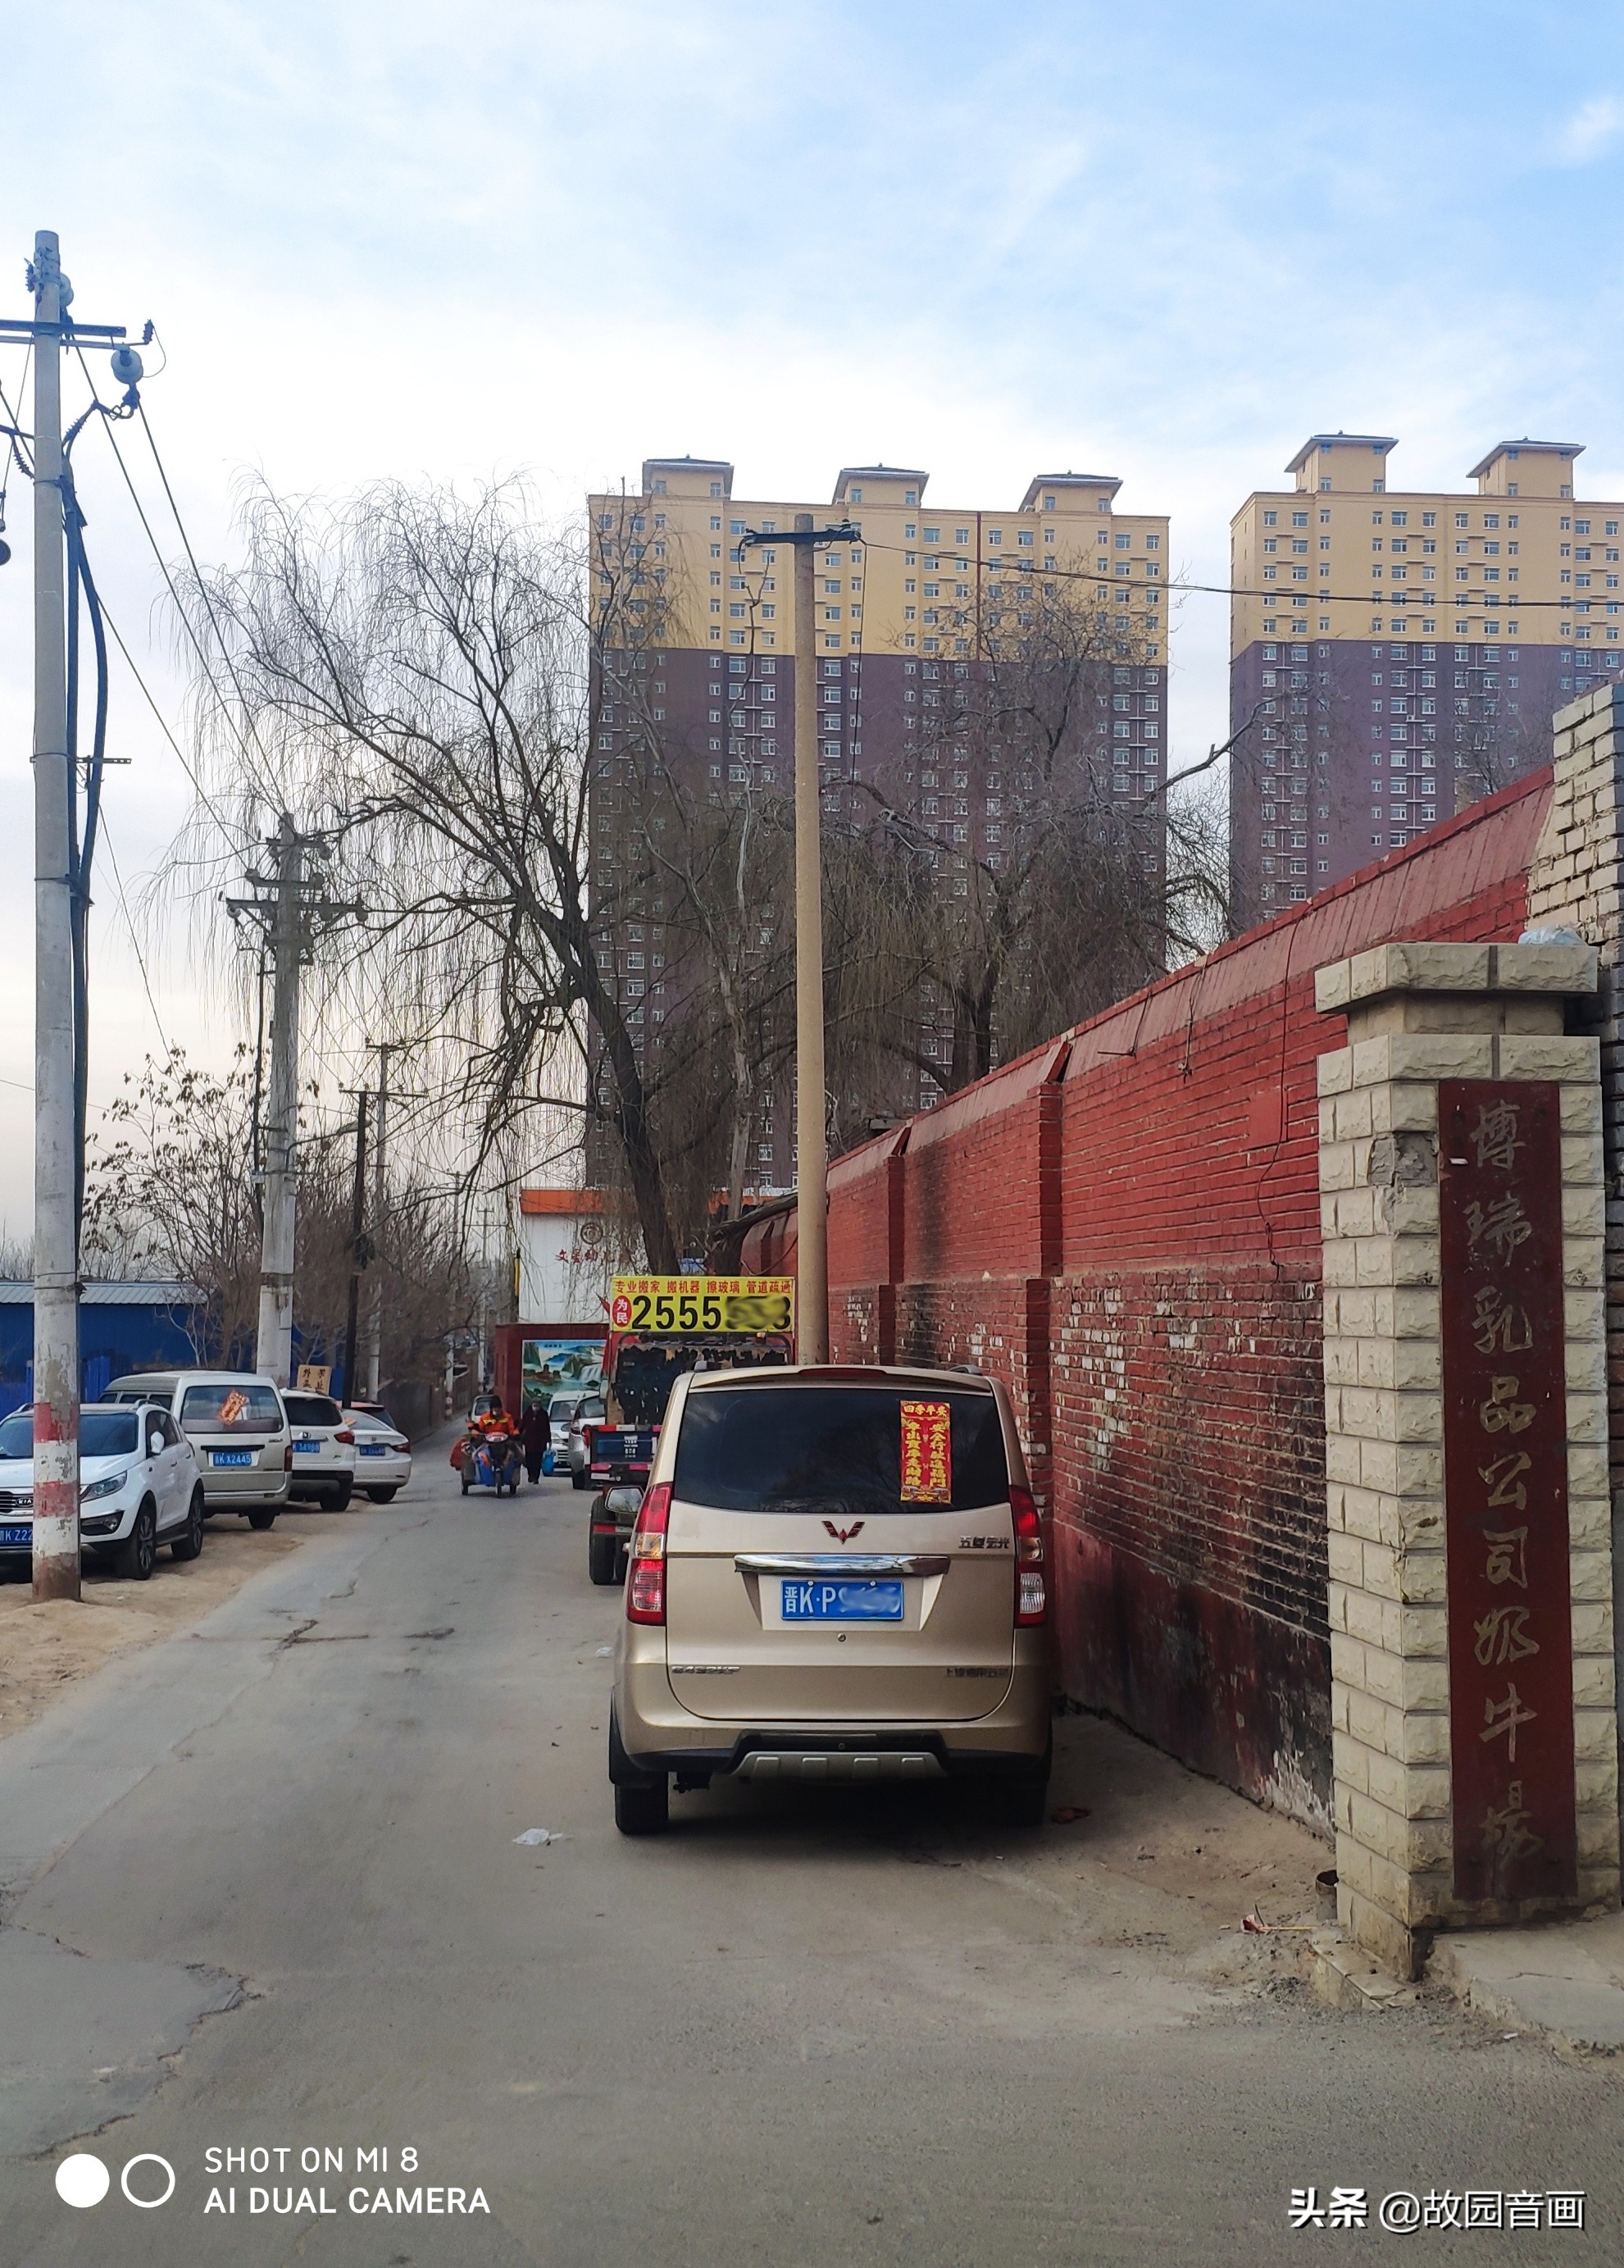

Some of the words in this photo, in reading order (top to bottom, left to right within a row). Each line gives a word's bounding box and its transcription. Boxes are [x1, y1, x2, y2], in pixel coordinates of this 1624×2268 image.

[615, 1280, 660, 1293] 专业搬家
[666, 1280, 700, 1293] 搬机器
[707, 1280, 740, 1294] 擦玻璃
[747, 1280, 791, 1294] 管道疏通
[616, 1299, 629, 1325] 为民
[632, 1296, 791, 1330] 2555
